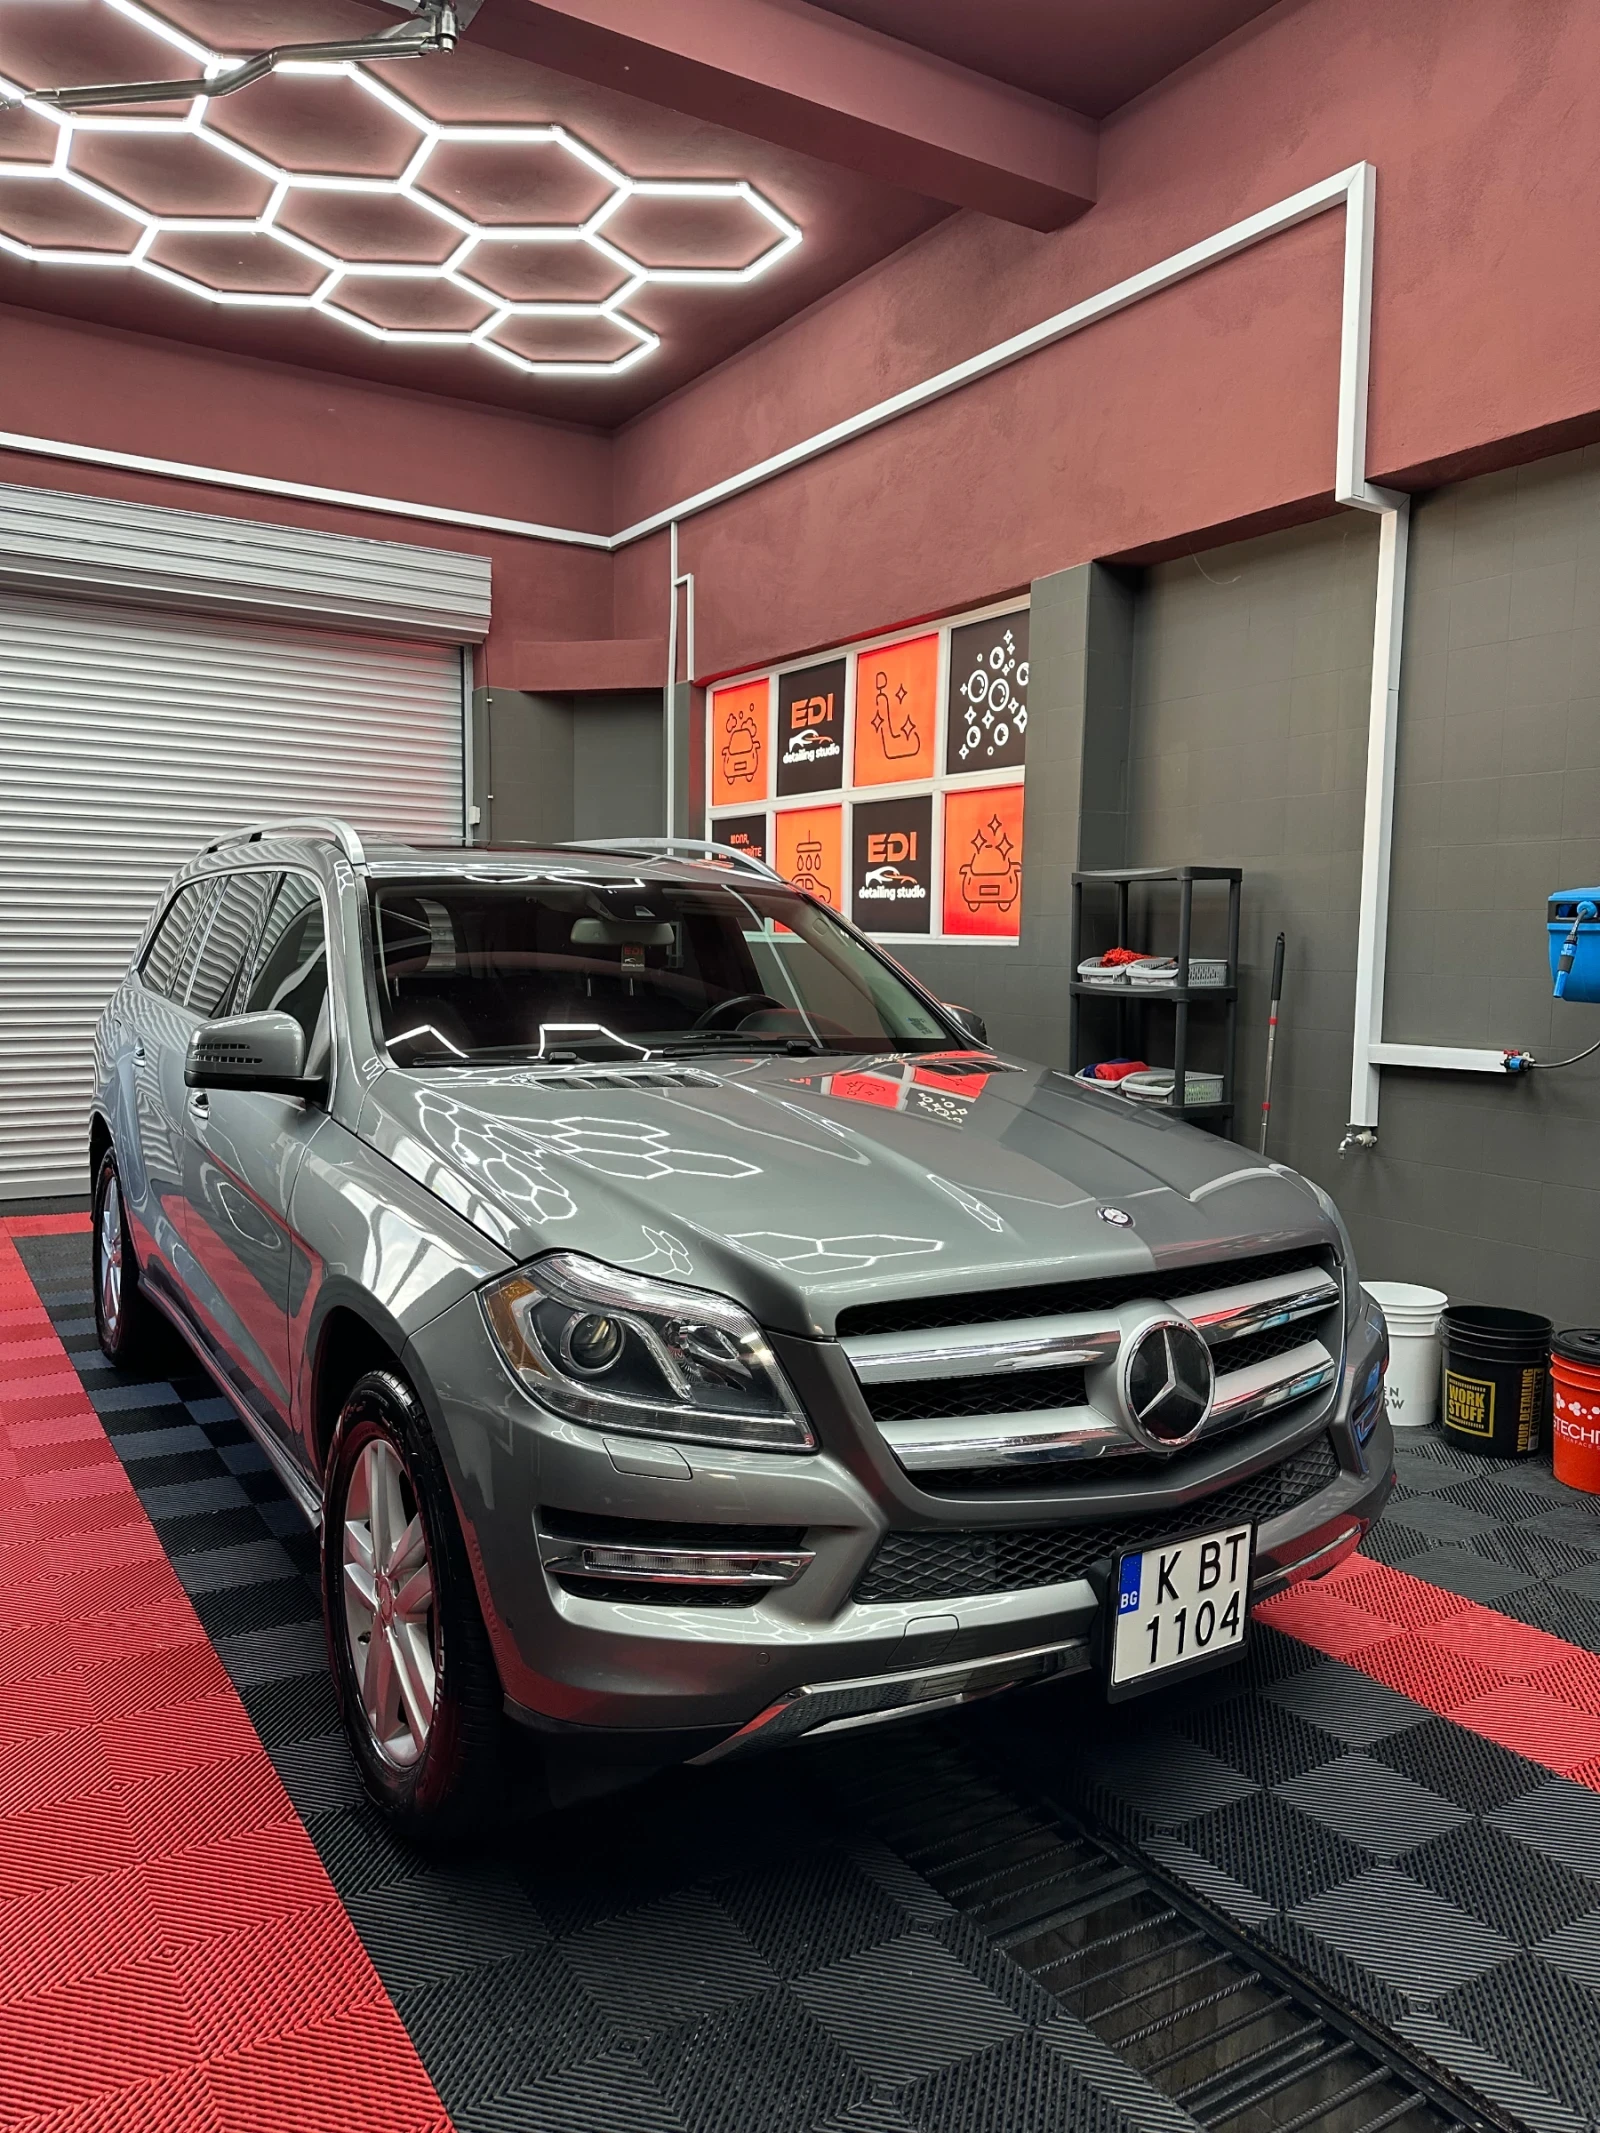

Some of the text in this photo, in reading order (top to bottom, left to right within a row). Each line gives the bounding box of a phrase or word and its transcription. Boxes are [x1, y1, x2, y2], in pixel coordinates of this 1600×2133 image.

[791, 693, 834, 729] EDI
[782, 743, 840, 764] detailing studio
[868, 832, 917, 863] EDI
[859, 884, 926, 901] detailing studio
[1450, 1384, 1485, 1408] WORK
[1449, 1399, 1485, 1423] STUFF
[1517, 1368, 1534, 1452] YOUR DETAILING
[1156, 1532, 1247, 1605] K BT
[1120, 1591, 1138, 1609] BG
[1146, 1590, 1241, 1664] 1104
